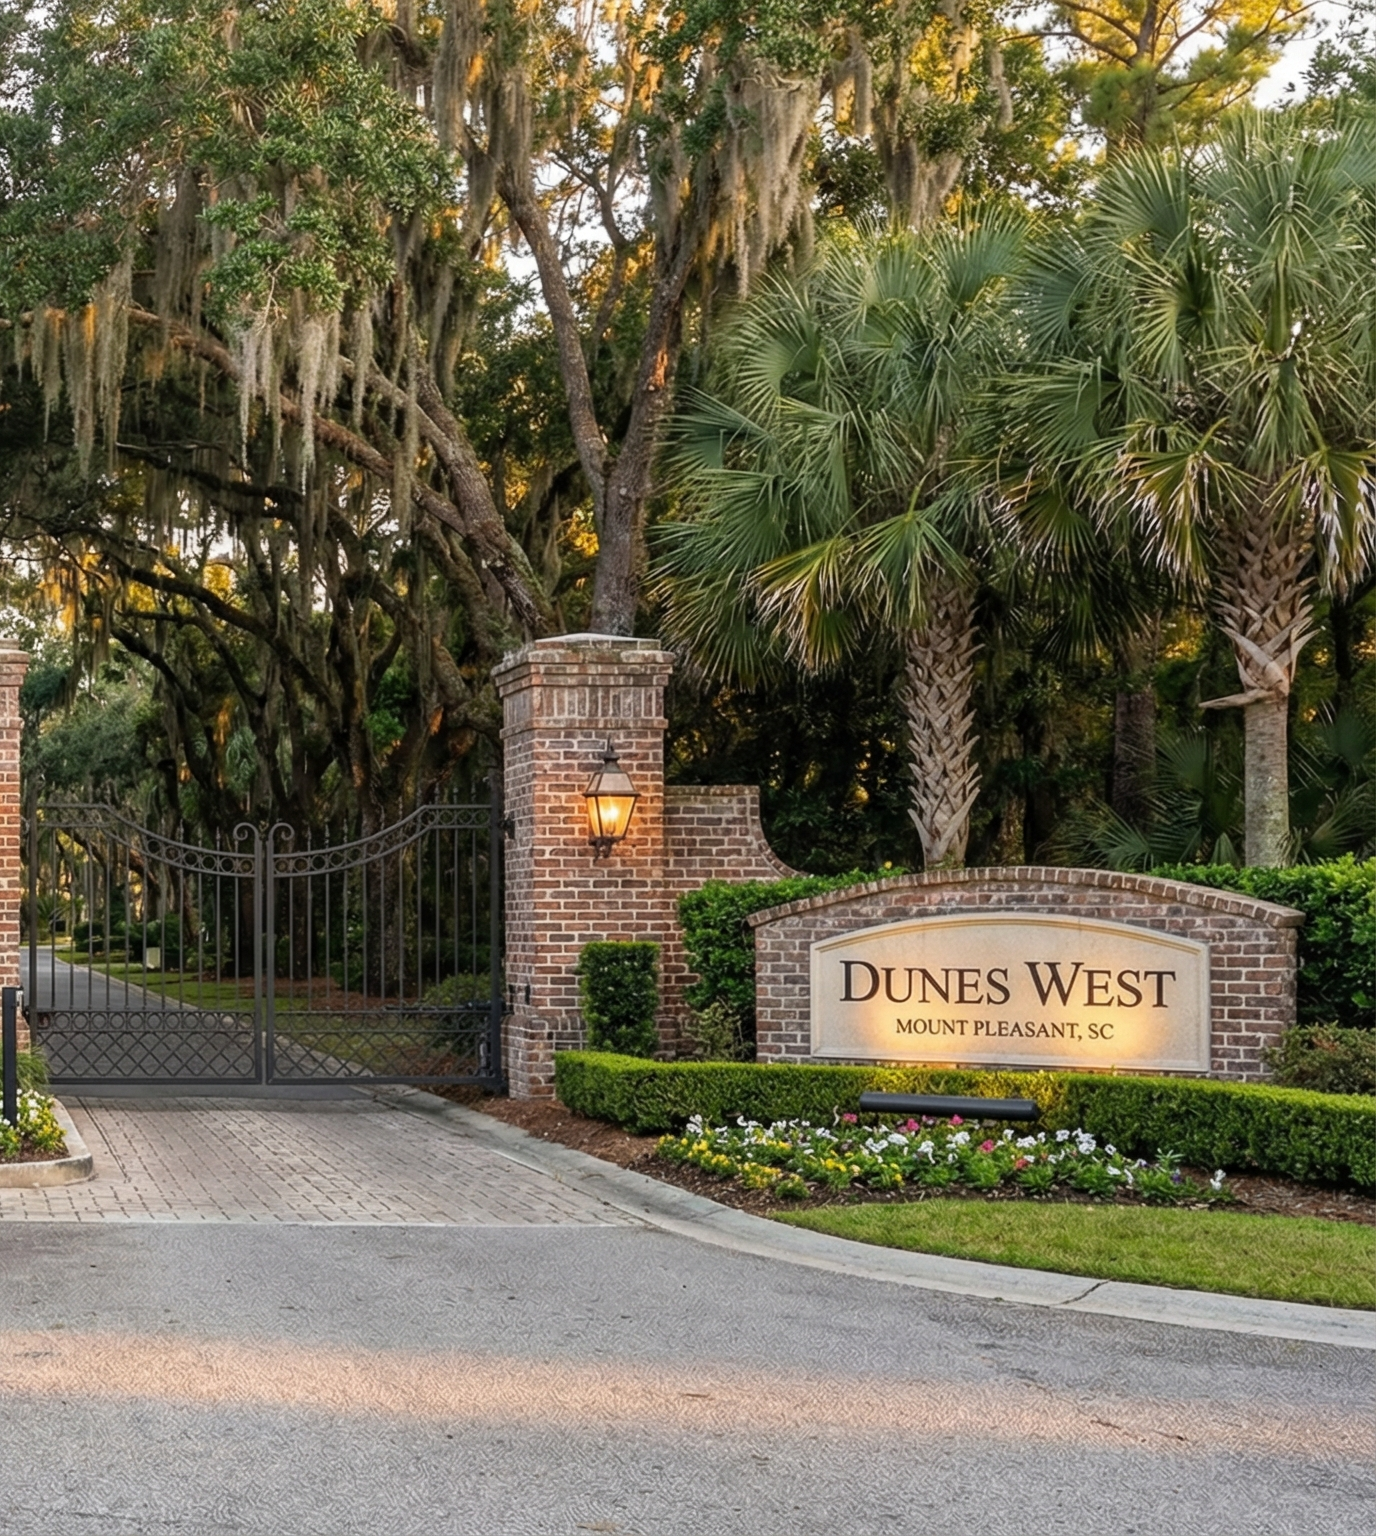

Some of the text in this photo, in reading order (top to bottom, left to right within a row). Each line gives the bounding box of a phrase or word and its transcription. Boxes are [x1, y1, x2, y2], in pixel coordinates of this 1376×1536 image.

[839, 960, 1176, 1008] DUNES WEST
[895, 1018, 1114, 1041] MOUNT PLEASANT, SC
